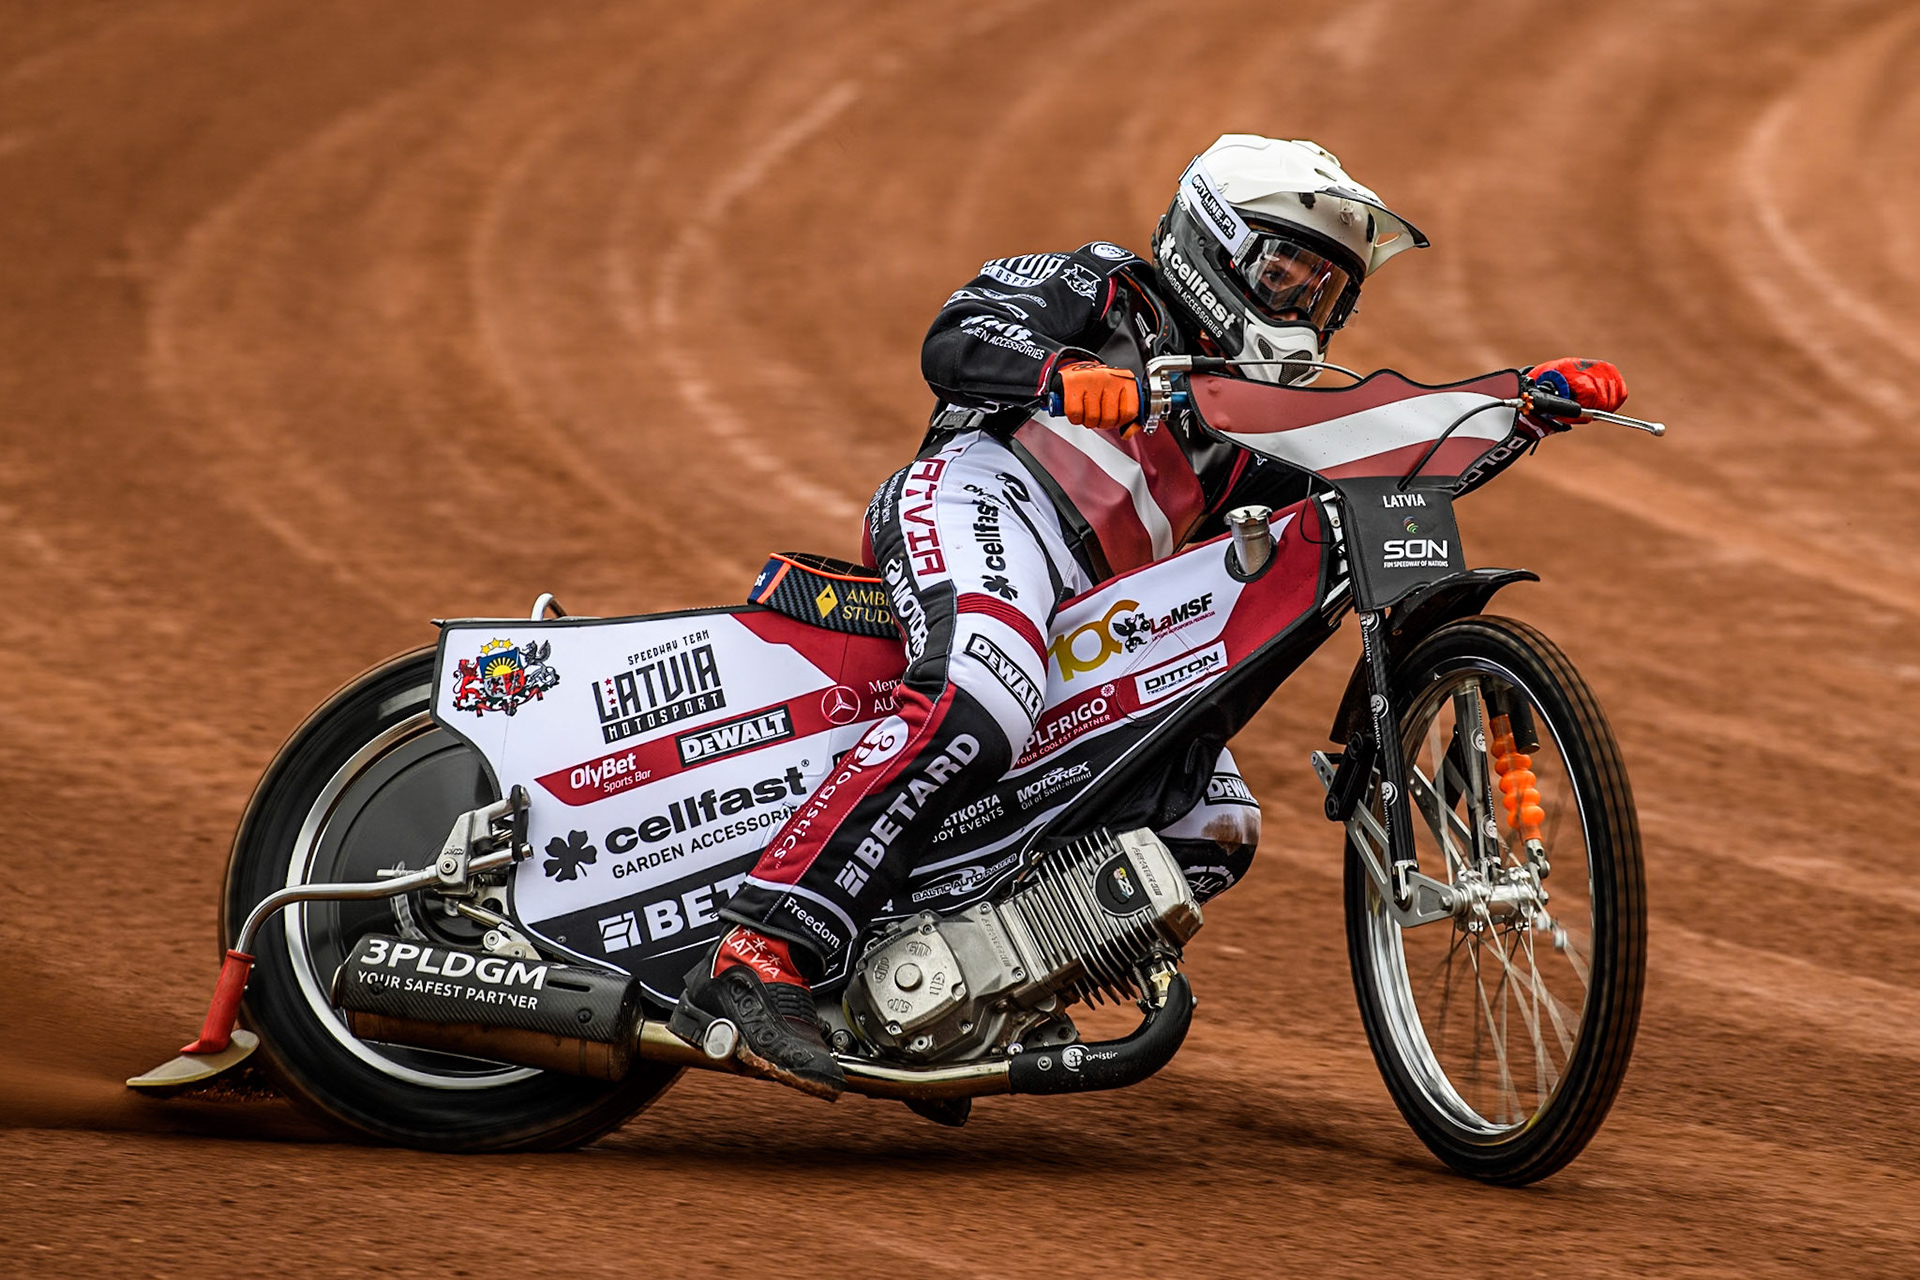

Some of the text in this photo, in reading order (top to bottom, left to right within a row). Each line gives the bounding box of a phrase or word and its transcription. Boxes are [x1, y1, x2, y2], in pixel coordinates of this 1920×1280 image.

[1170, 251, 1238, 331] cellfast
[1181, 290, 1223, 338] ACCESSORIES
[1383, 494, 1426, 508] LATVIA
[1383, 539, 1448, 559] SON
[1149, 592, 1213, 635] LaMSF
[627, 629, 710, 666] SPEEDWAY TEAM
[592, 643, 721, 723] LATVIA
[1144, 651, 1219, 691] DITTON
[608, 691, 721, 741] MOTOSPORT
[1039, 732, 1072, 755] COOLEST
[1073, 714, 1111, 736] PARTNER
[570, 752, 637, 790] OlyBet
[603, 769, 651, 793] Sports Bar
[1016, 761, 1090, 803] MOTOREX
[1035, 795, 1043, 804] of
[1044, 771, 1092, 798] Switzerland
[605, 766, 807, 854] cellfast
[774, 762, 863, 860] logistics
[855, 733, 980, 869] BETARD
[943, 794, 1001, 828] ETKOSTA
[959, 806, 1004, 834] EVENTS
[612, 843, 685, 879] GARDEN
[912, 883, 952, 902] BALTIC
[950, 873, 983, 891] AUTO
[784, 896, 841, 949] Freedom
[360, 938, 548, 990] 3PLDGM
[726, 931, 781, 979] LATVIA
[357, 970, 538, 1011] YOUR SAFEST PARTNER
